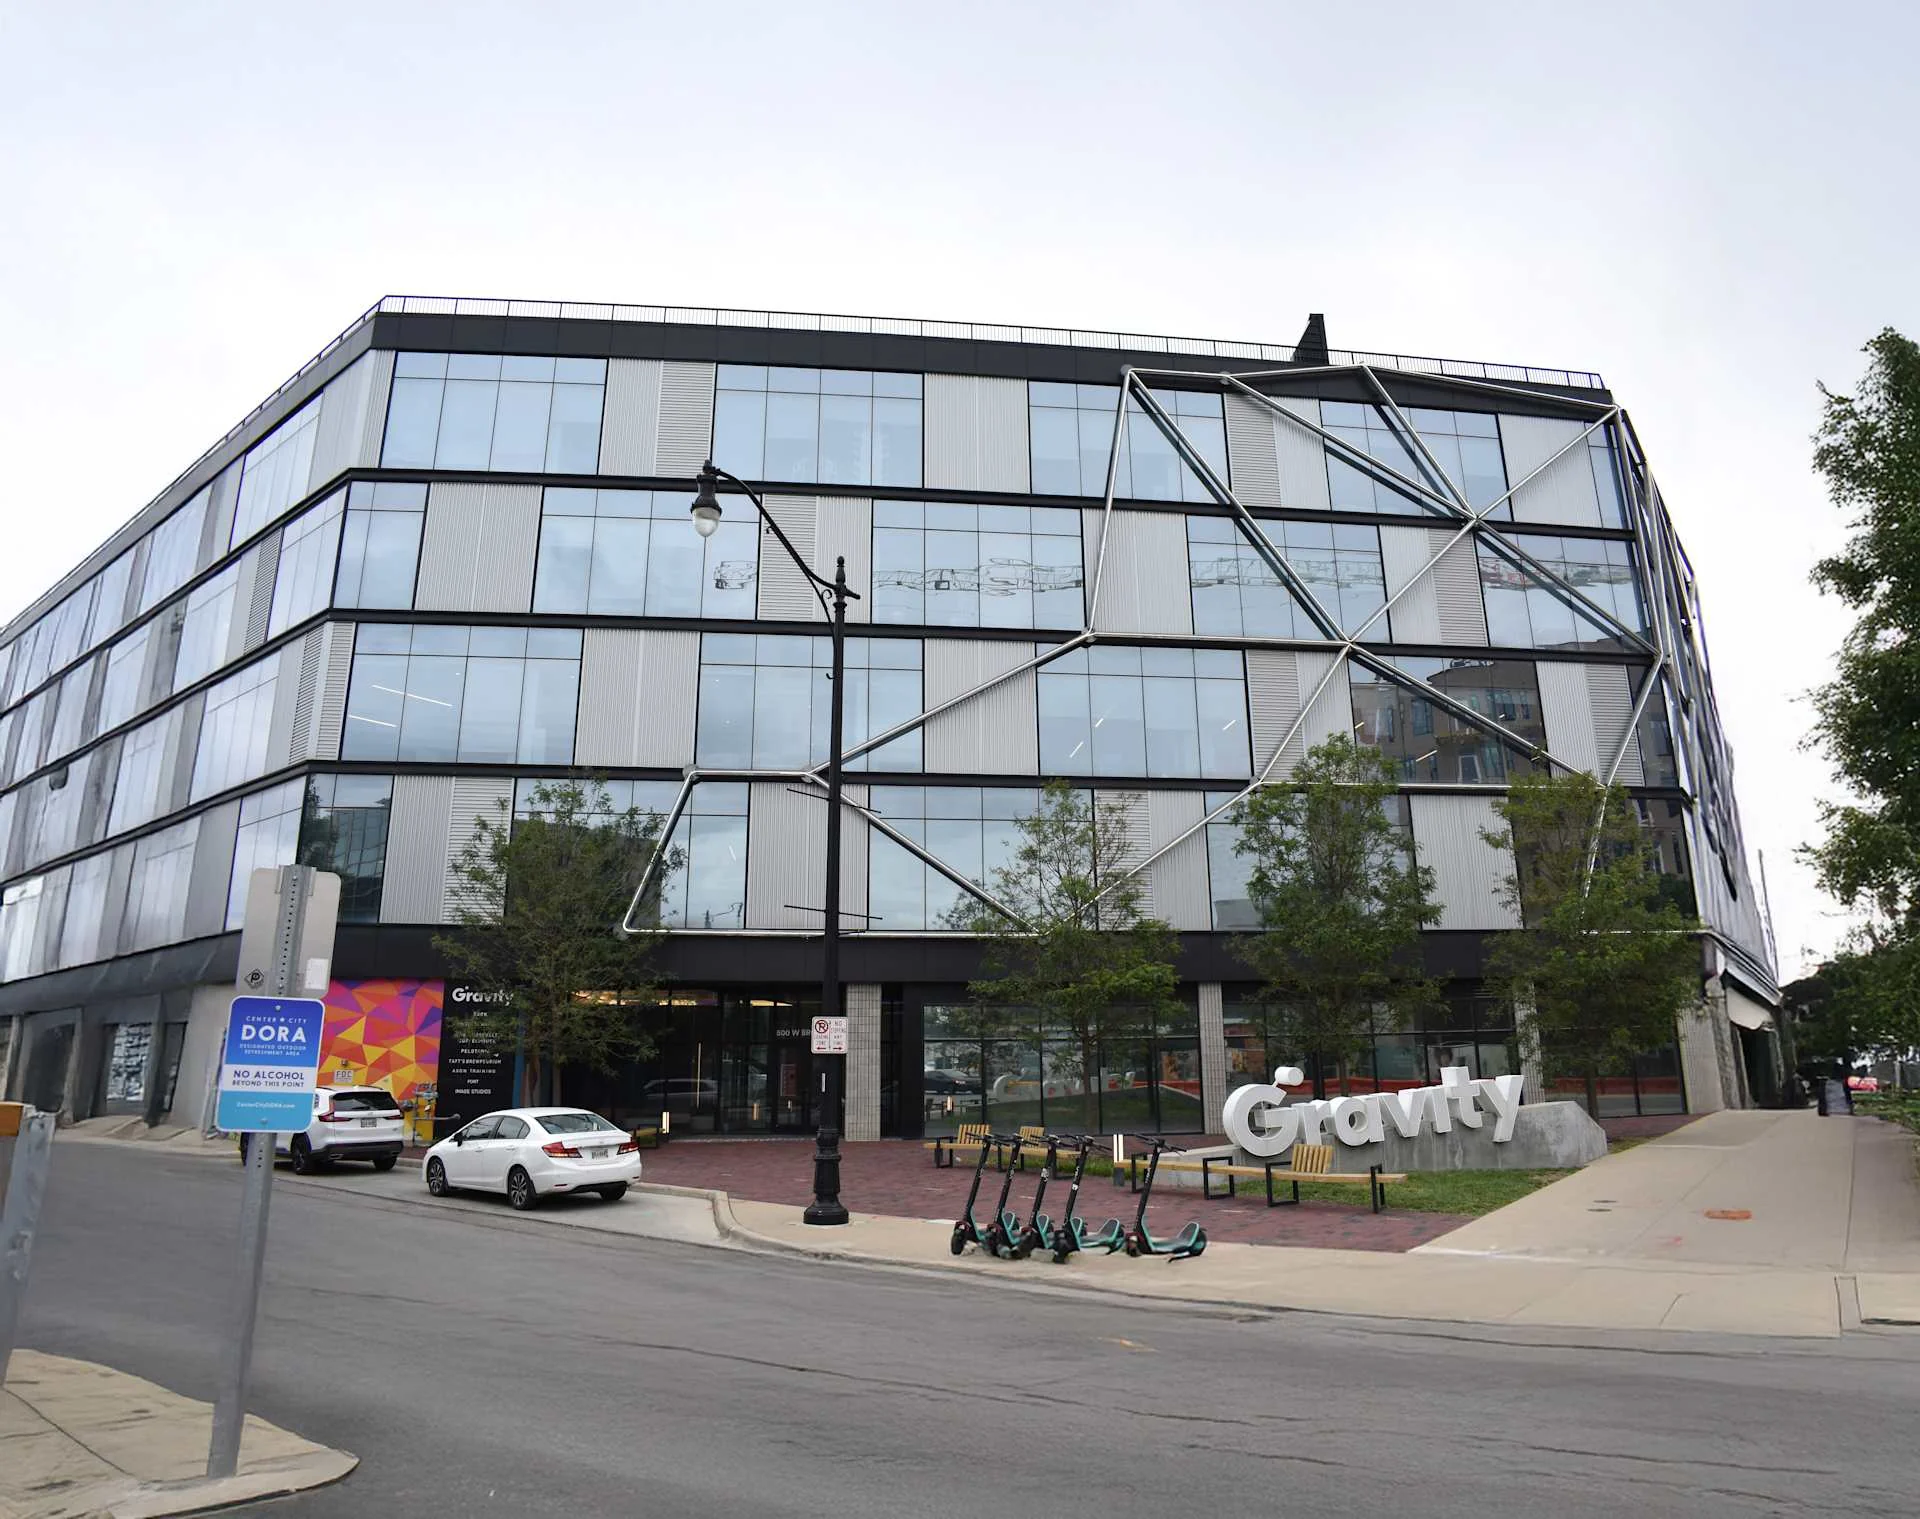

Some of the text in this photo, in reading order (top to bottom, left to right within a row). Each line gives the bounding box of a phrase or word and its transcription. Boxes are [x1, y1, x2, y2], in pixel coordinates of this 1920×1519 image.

[452, 986, 514, 1006] Gravity
[245, 1015, 276, 1023] CENTER
[241, 1024, 306, 1043] DORA
[801, 1029, 811, 1037] BR
[233, 1069, 304, 1079] NO ALCOHOL
[336, 1070, 353, 1078] FDC
[1223, 1066, 1524, 1157] Gravity
